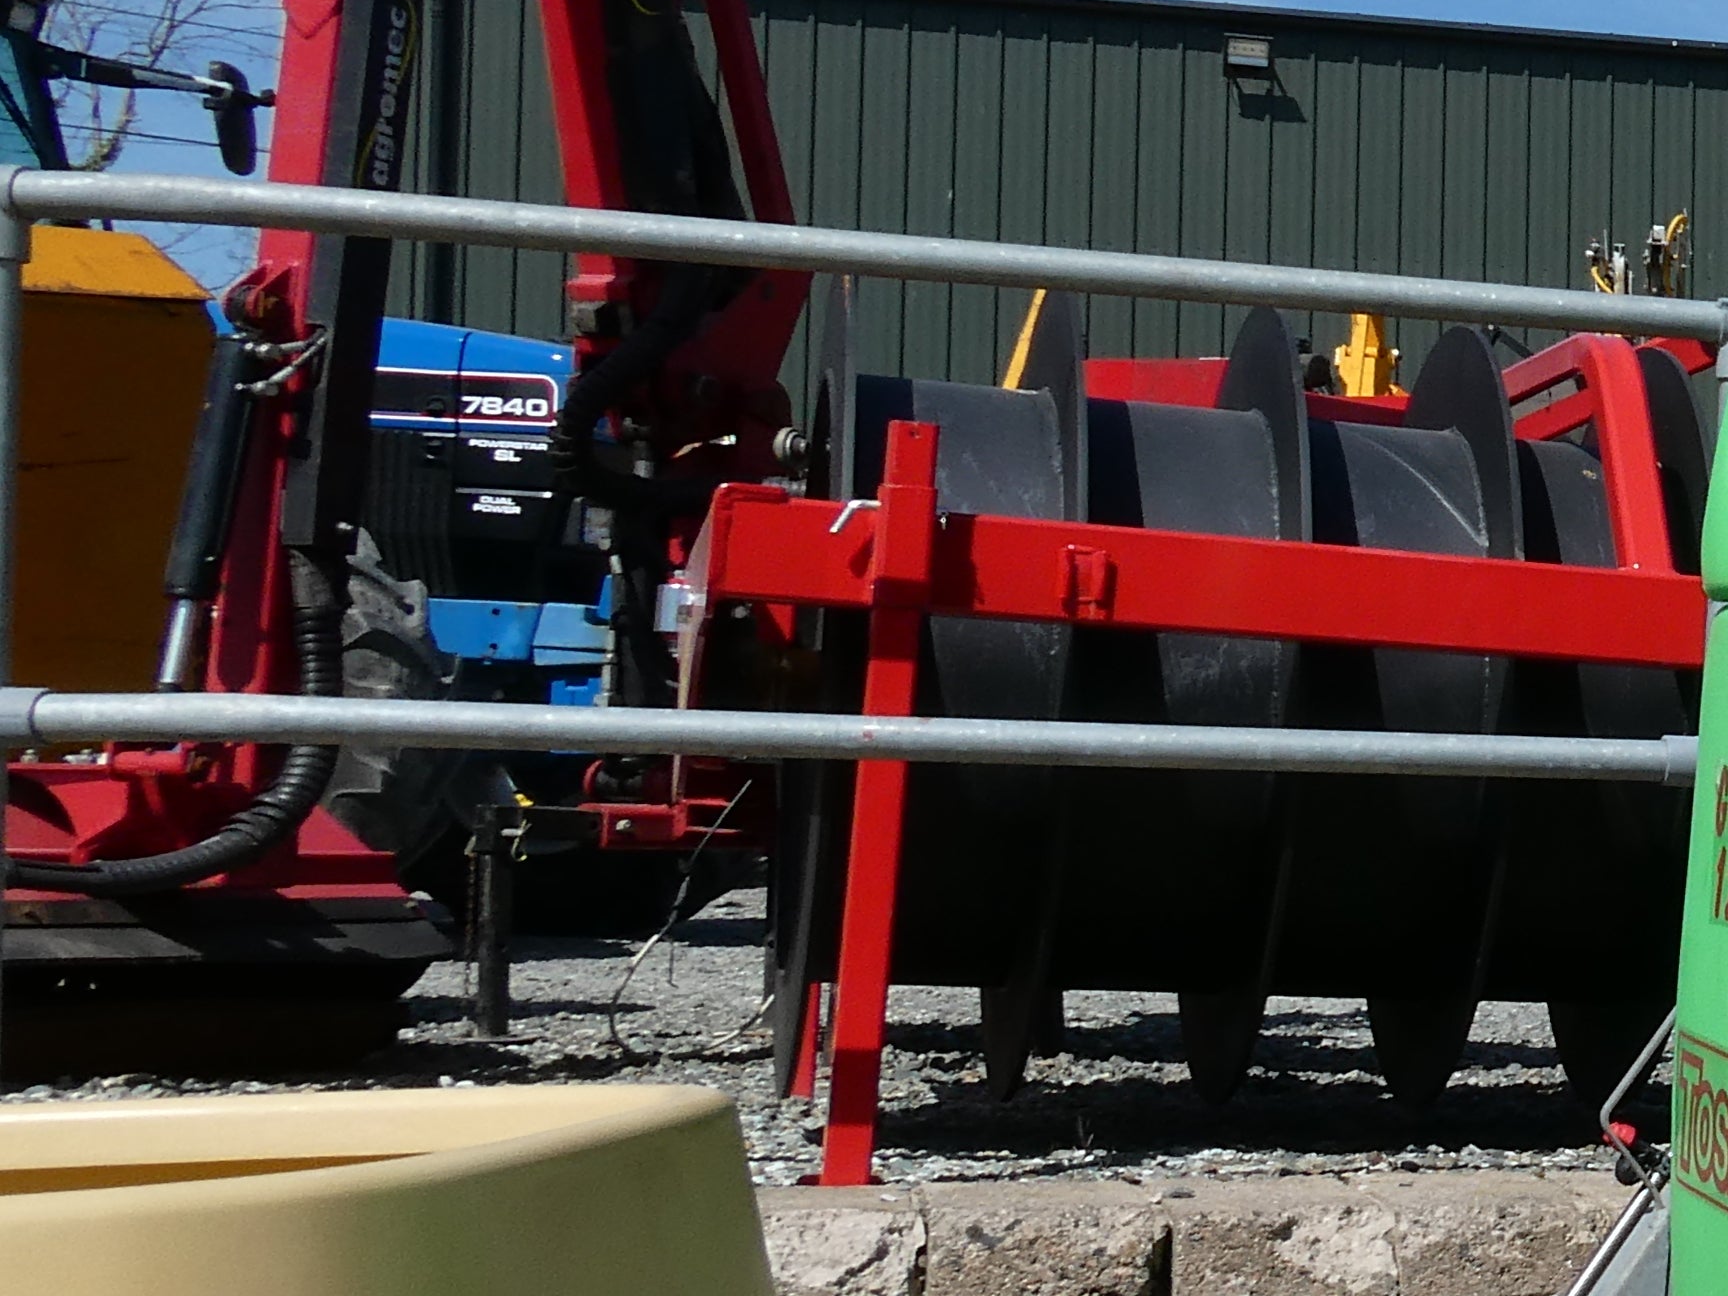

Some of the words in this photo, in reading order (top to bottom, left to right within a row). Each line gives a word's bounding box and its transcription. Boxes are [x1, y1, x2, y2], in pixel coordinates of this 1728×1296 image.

[372, 7, 407, 186] agromec
[461, 396, 548, 417] 7840
[468, 439, 549, 451] POWERSTAR
[493, 449, 522, 462] SL
[479, 496, 516, 505] DUAL
[472, 503, 522, 514] POWER
